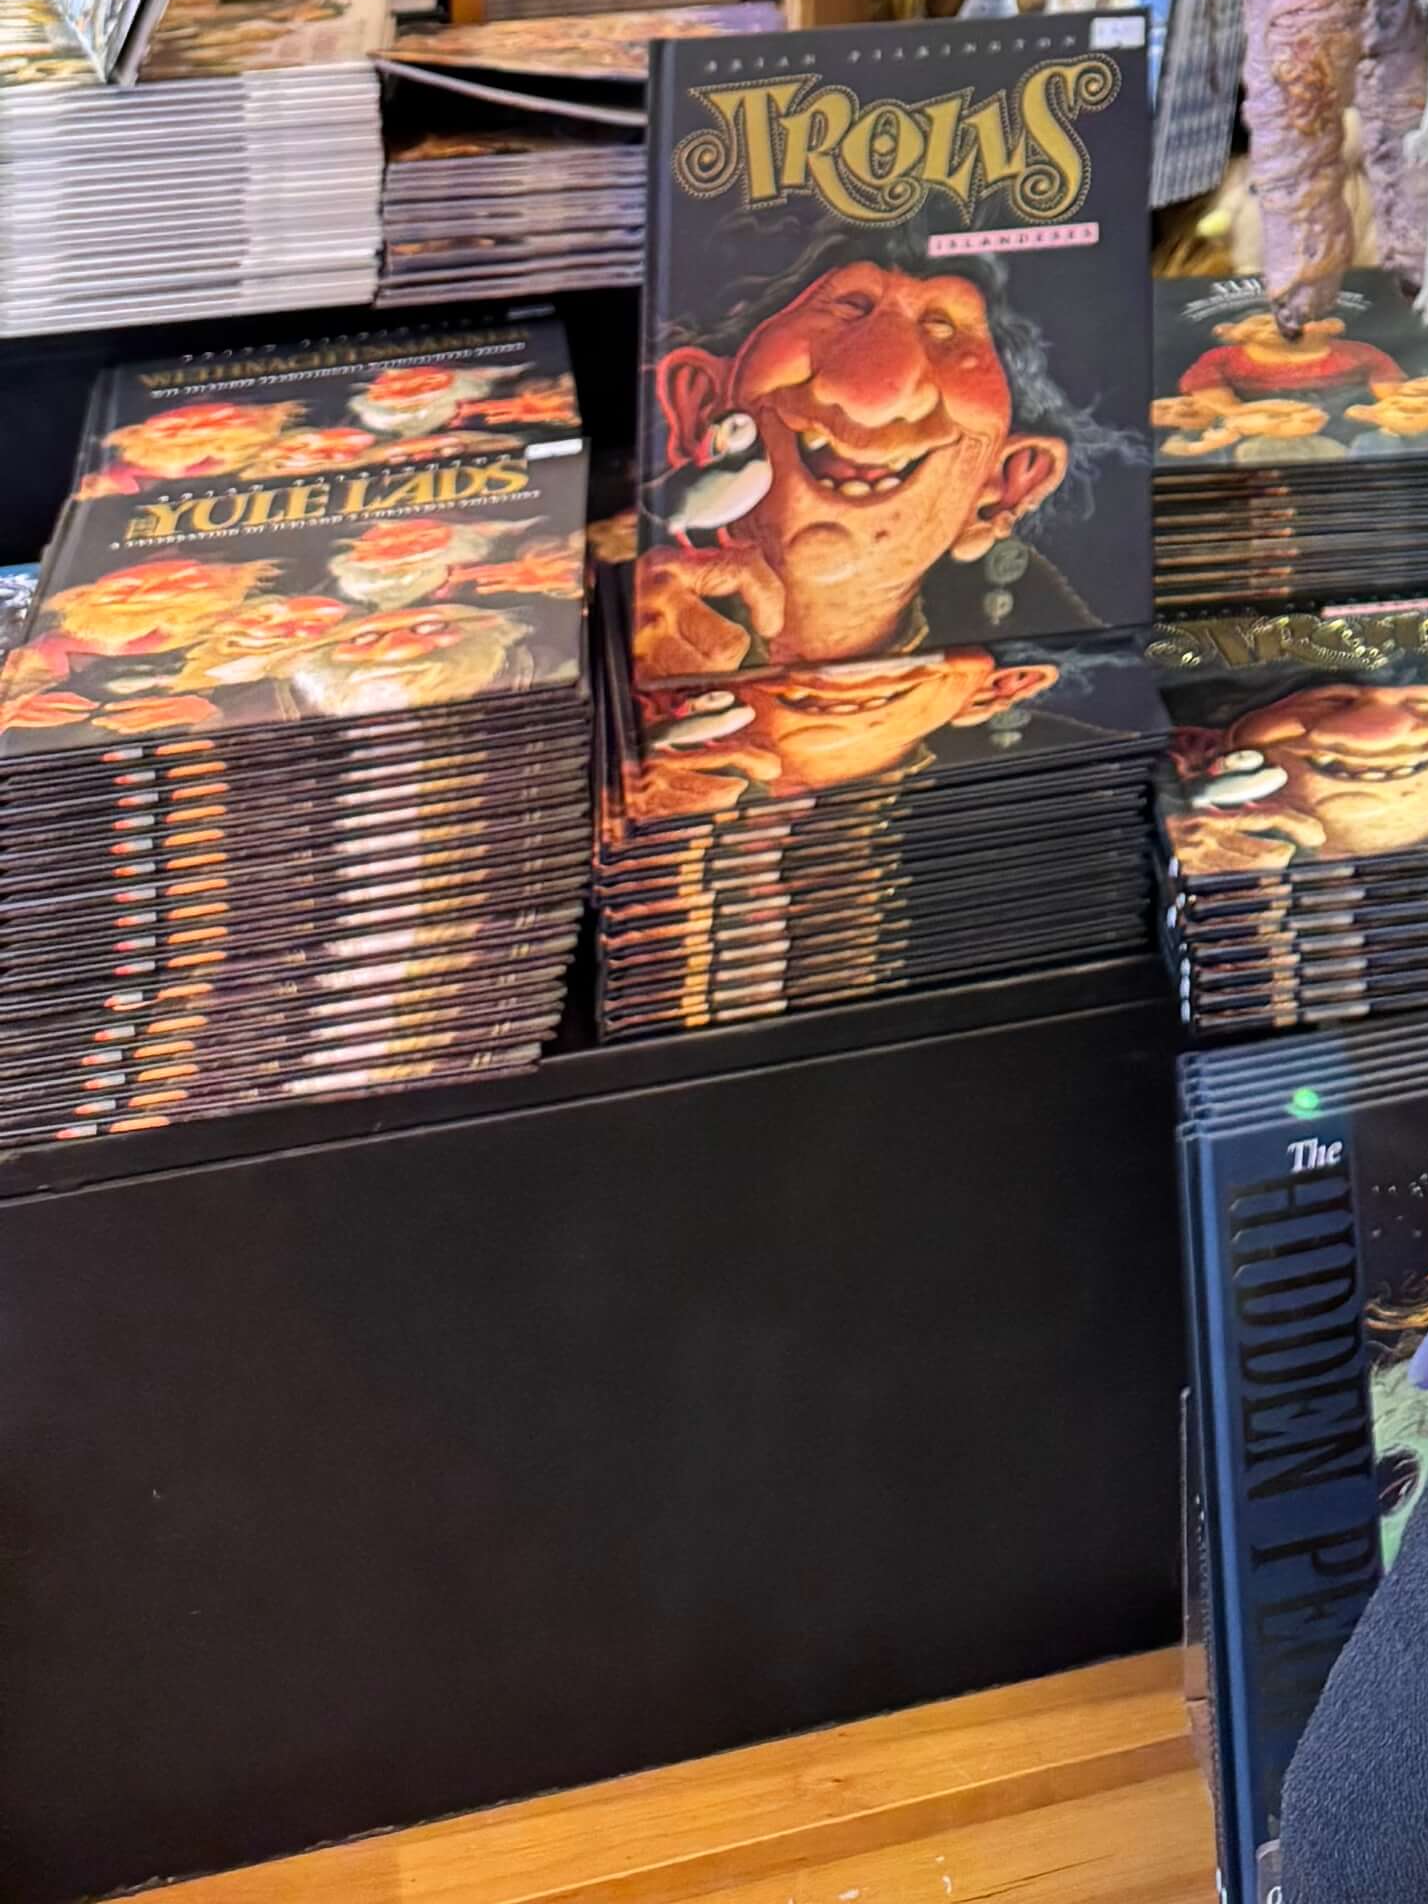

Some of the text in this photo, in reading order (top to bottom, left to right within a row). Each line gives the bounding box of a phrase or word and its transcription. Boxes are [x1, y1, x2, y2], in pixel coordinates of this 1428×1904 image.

[673, 53, 1122, 228] TROLLS
[137, 483, 332, 538] YULE
[338, 457, 530, 515] LADS
[1287, 1137, 1343, 1174] The
[1228, 1168, 1373, 1501] HIDDEN
